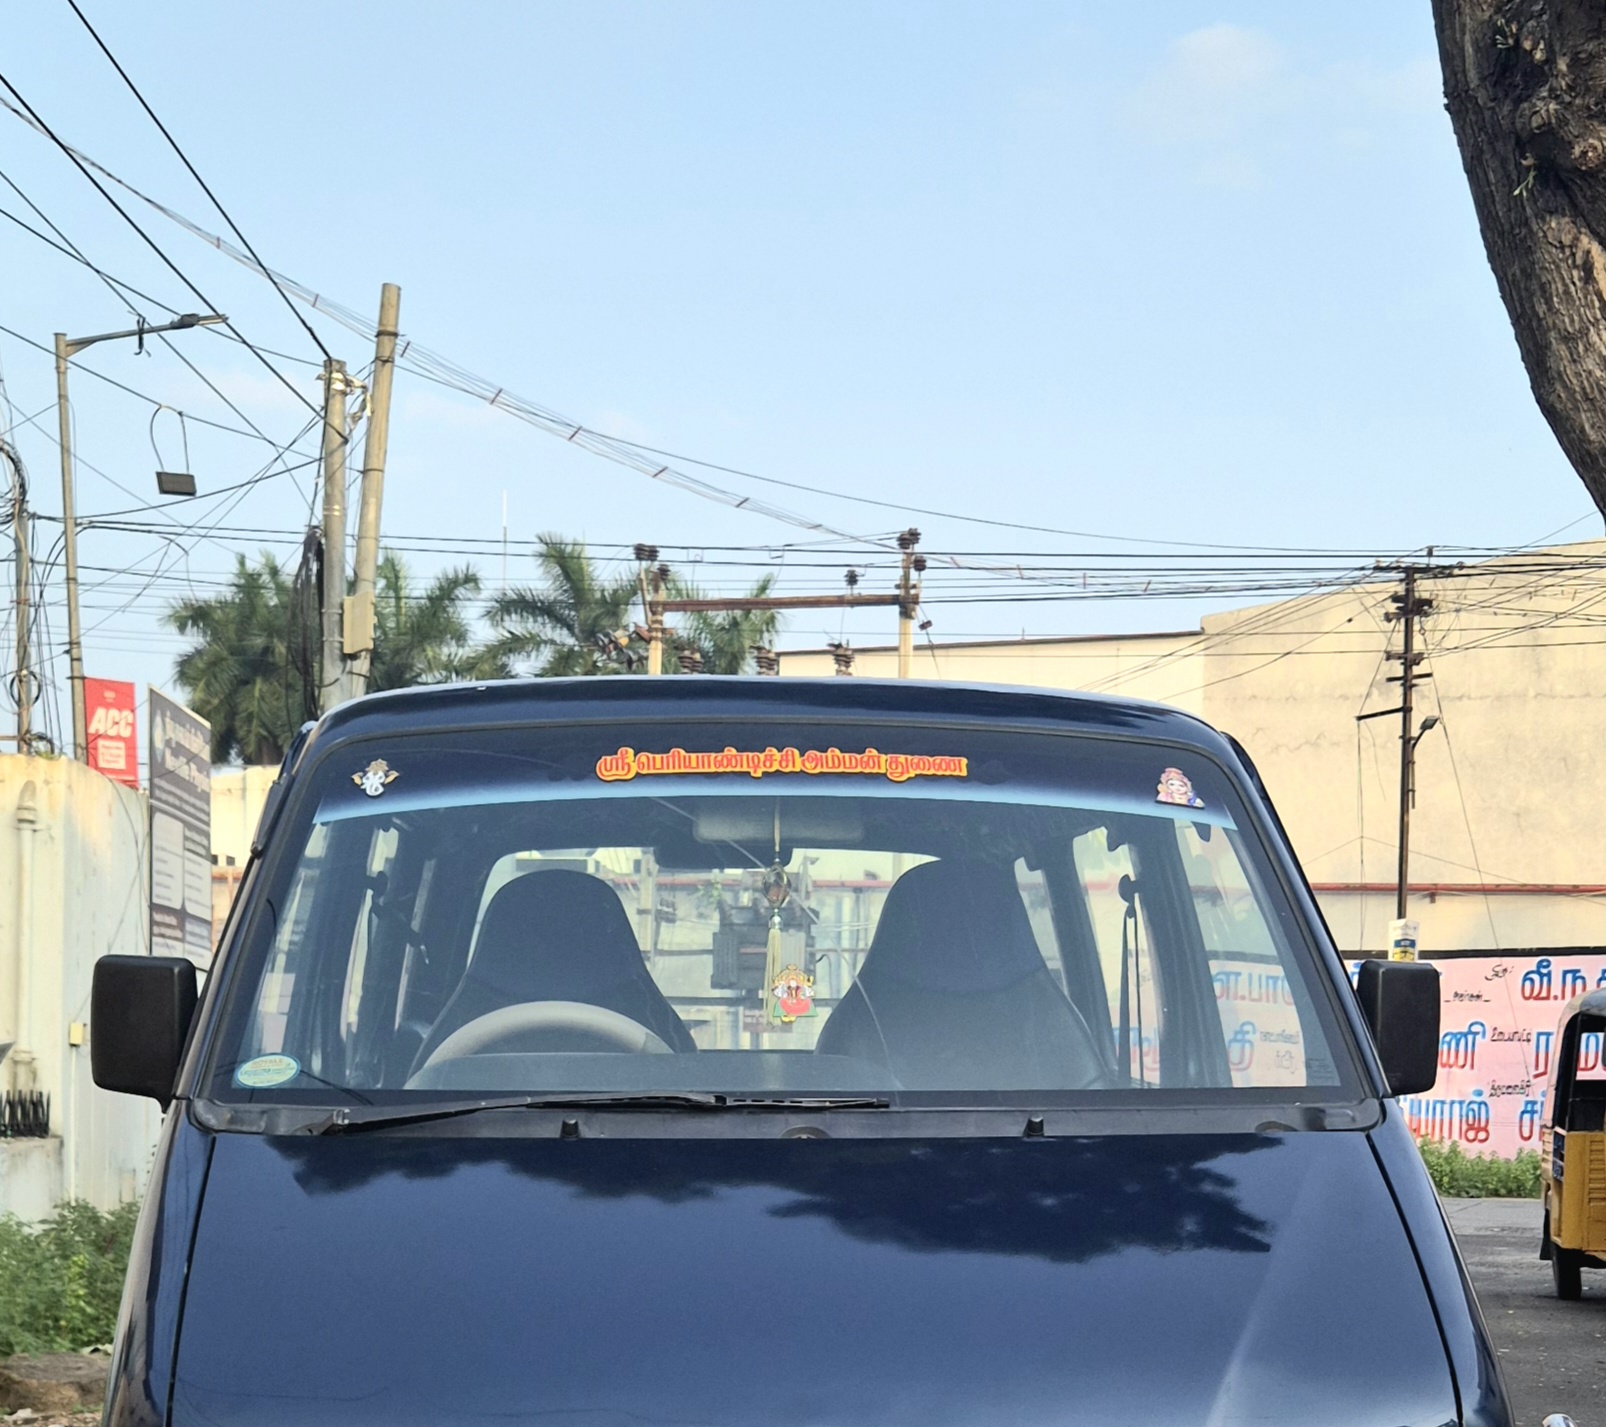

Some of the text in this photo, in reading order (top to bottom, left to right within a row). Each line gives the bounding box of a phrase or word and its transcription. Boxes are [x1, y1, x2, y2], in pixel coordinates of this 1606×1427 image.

[88, 707, 134, 738] ACC
[636, 747, 799, 777] பெரியாண்டிச்சி
[800, 748, 886, 773] அம்மன்
[887, 754, 967, 781] துணை
[1439, 1021, 1486, 1070] ணி
